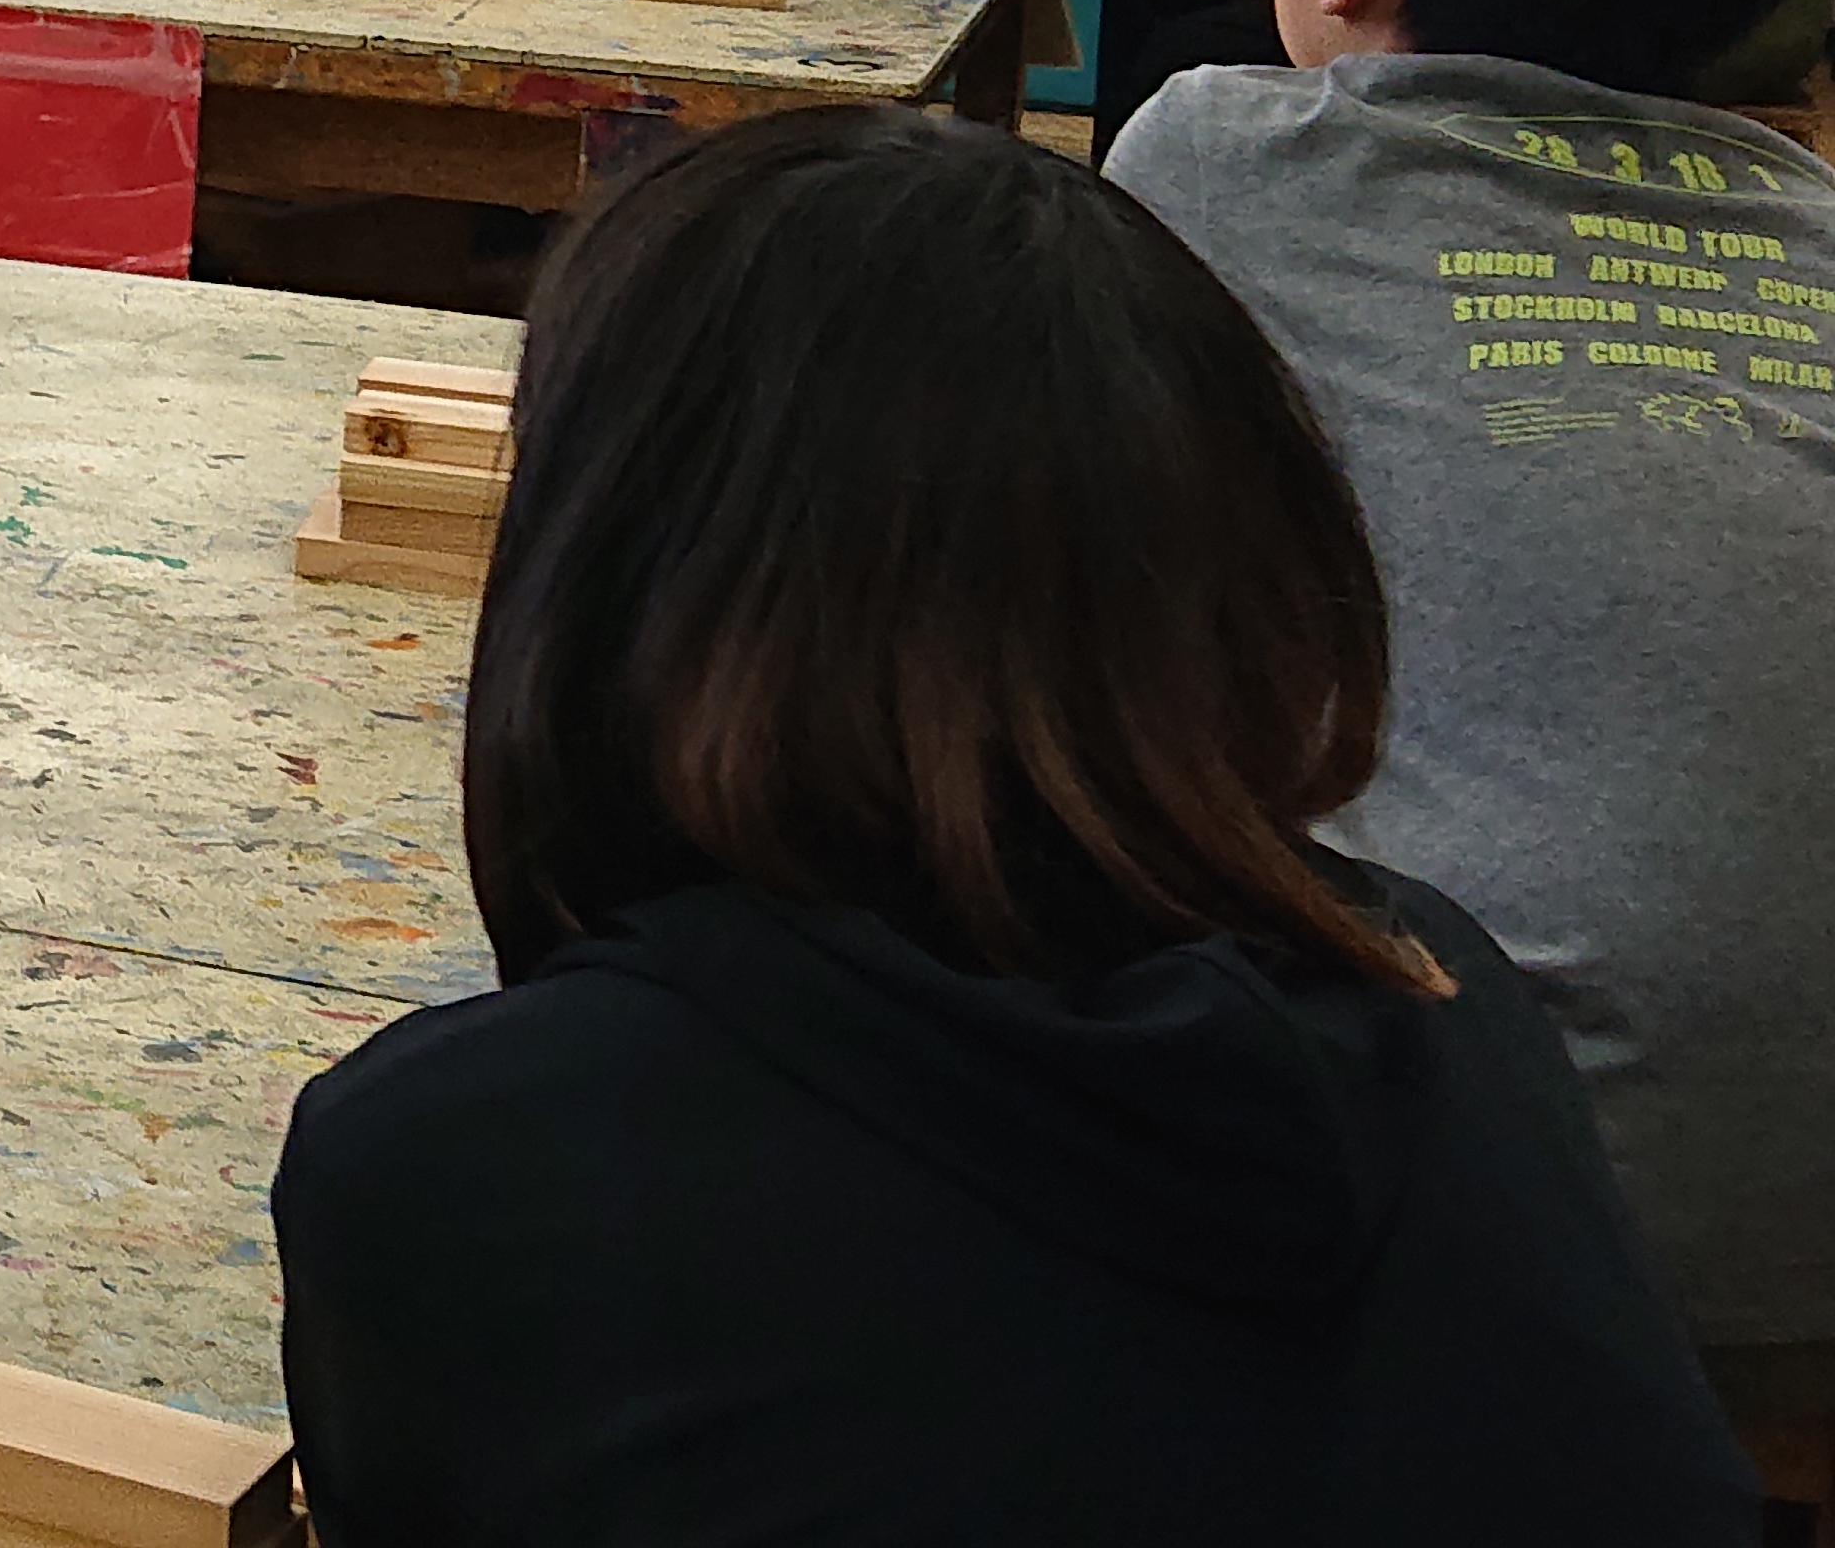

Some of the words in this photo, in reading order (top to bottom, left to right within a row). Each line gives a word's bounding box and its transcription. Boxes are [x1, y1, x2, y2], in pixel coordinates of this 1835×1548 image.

[1569, 213, 1688, 253] WORLD
[1697, 230, 1785, 263] TOUR
[1438, 251, 1555, 279] LONDON
[1589, 254, 1728, 291] ANTWERP
[1452, 295, 1637, 323] STOCKHOLM
[1657, 304, 1821, 345] BARCELONA
[1469, 339, 1564, 370] PARIS
[1588, 341, 1719, 375] COLOGNE
[1748, 354, 1833, 392] MILAN
